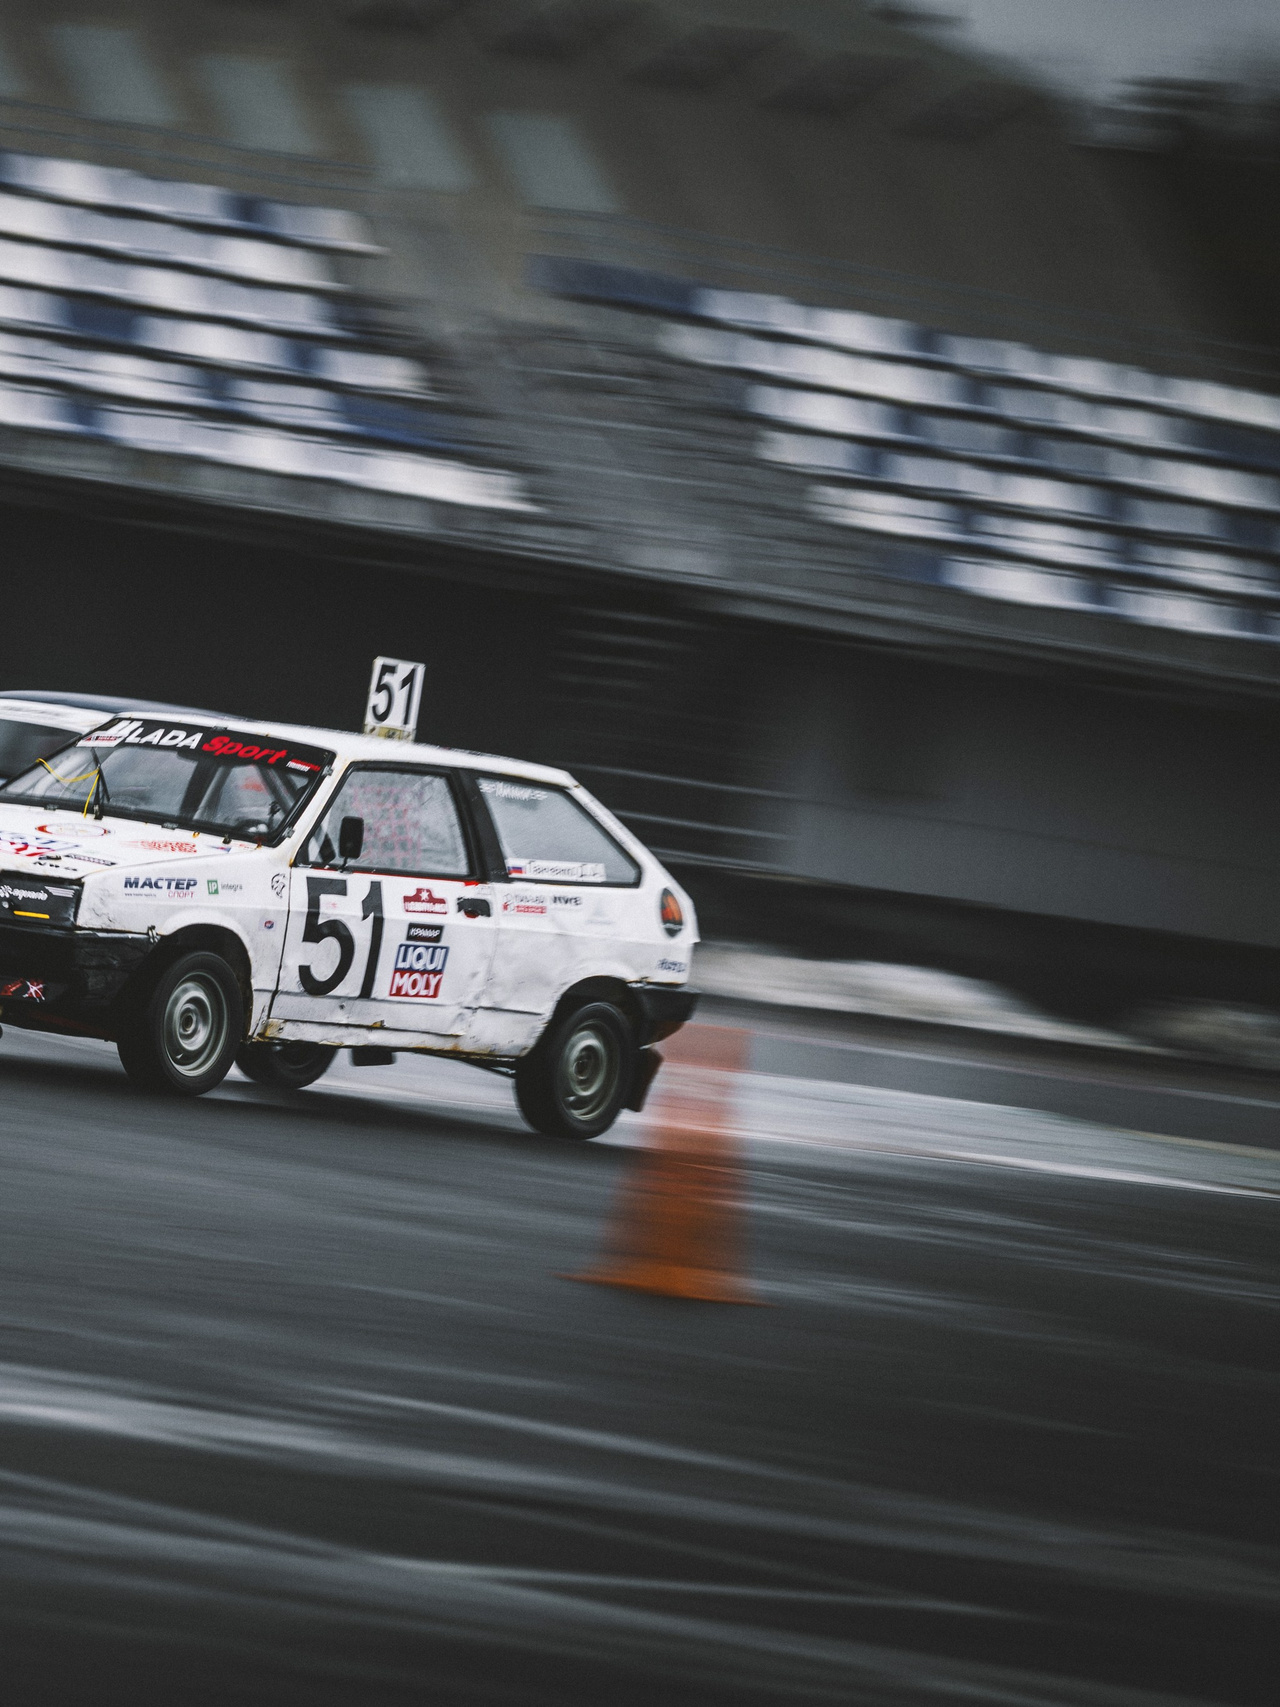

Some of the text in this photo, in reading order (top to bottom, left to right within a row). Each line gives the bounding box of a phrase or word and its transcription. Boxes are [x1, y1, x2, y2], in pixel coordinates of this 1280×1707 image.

[371, 664, 418, 726] 51
[123, 727, 203, 750] LADA
[202, 736, 288, 765] Sport
[123, 876, 198, 891] МАСТЕР
[298, 876, 384, 999] 51
[396, 945, 447, 971] LIQUI
[391, 972, 442, 997] MOLY
